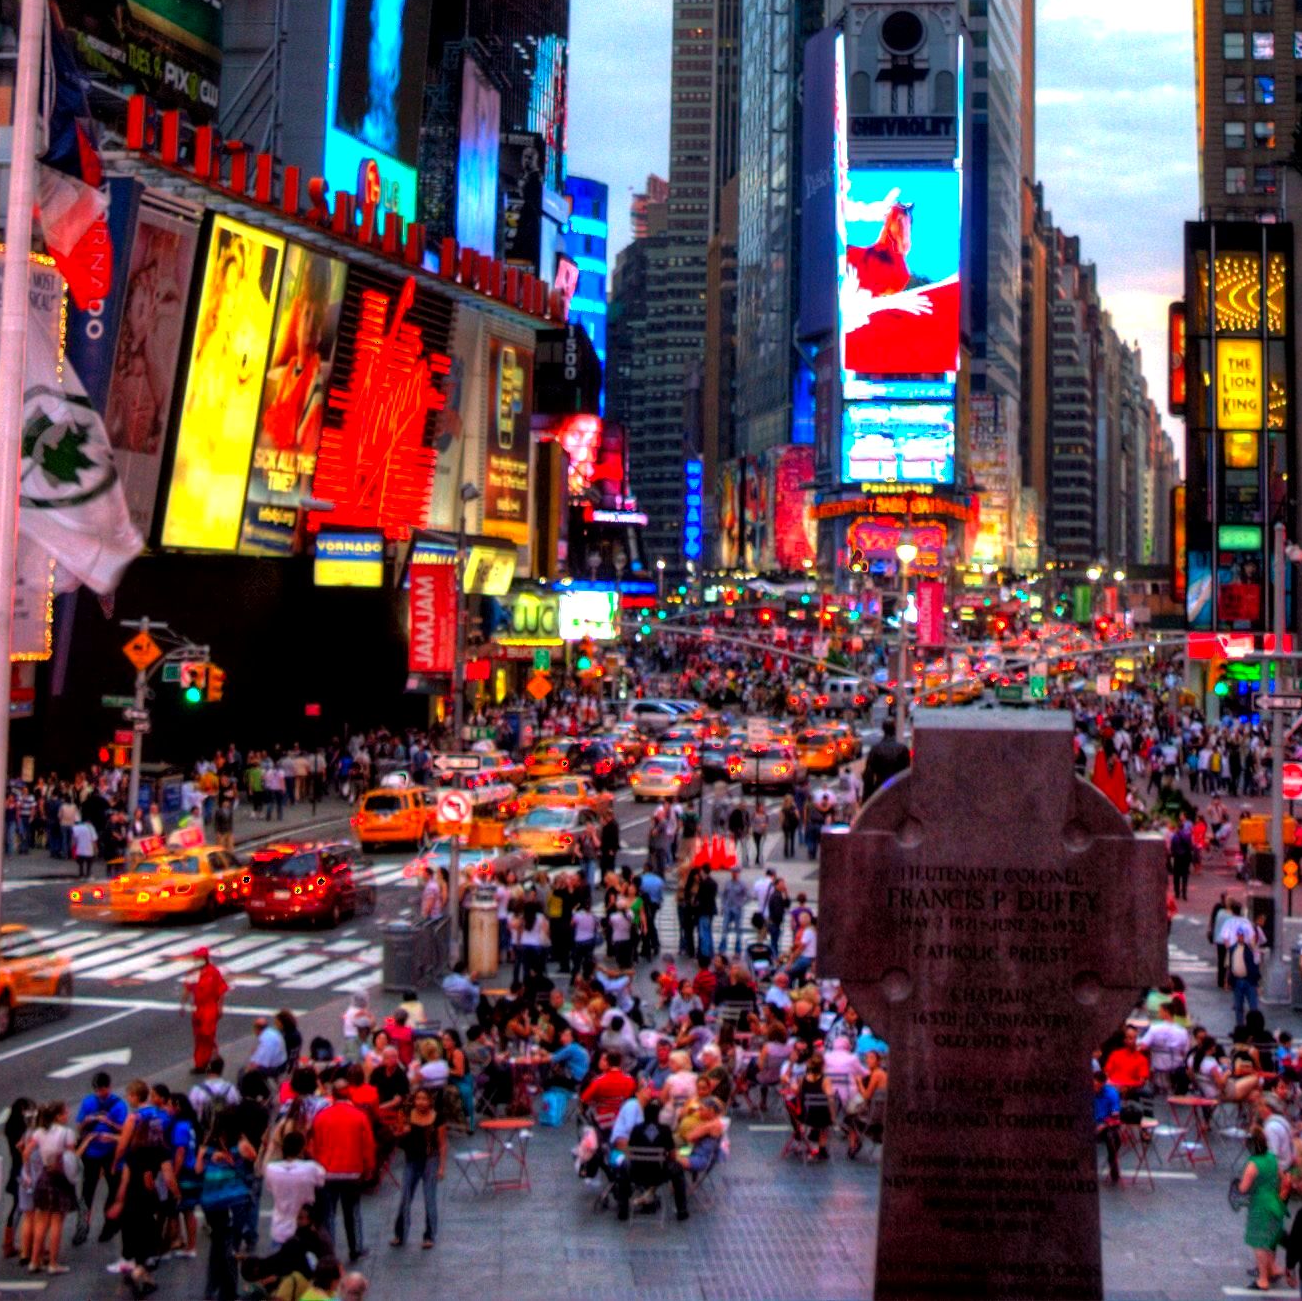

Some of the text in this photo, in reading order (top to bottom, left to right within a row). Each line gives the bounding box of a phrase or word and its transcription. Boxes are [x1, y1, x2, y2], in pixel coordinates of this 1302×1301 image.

[1227, 357, 1252, 372] THE
[1222, 372, 1257, 390] LION
[1222, 396, 1258, 417] KING
[861, 482, 935, 495] Panasonic
[315, 539, 383, 553] VORNADO
[413, 574, 436, 669] JAMJAM
[1003, 867, 1084, 887] COLONEL
[886, 886, 985, 911] FRANCIS
[1017, 889, 1102, 913] DUFFY
[912, 943, 1072, 963] CATHOLIC PRIEST
